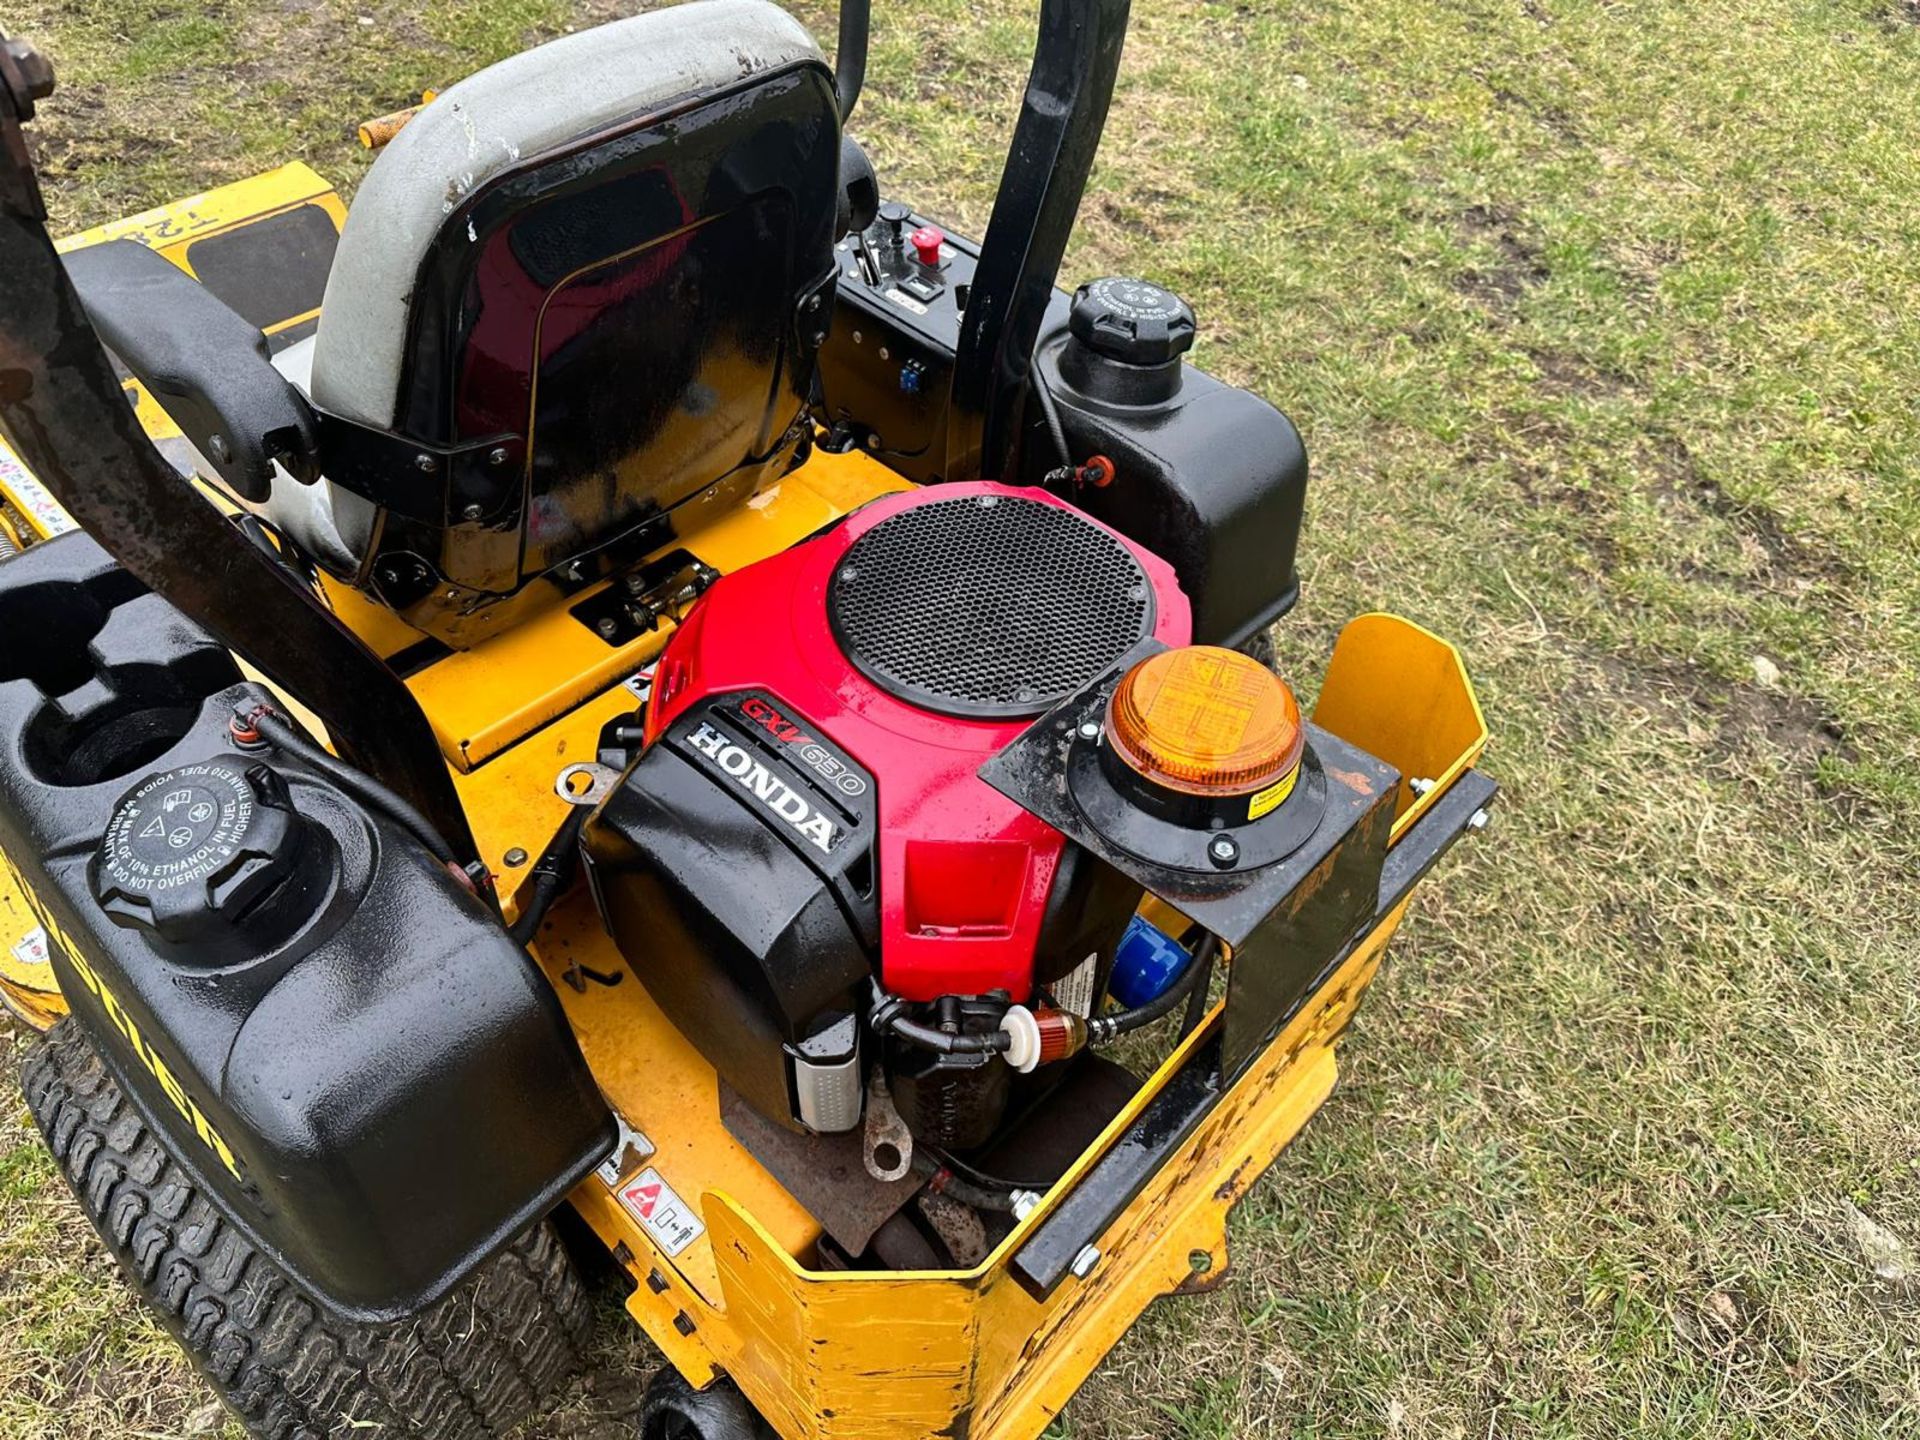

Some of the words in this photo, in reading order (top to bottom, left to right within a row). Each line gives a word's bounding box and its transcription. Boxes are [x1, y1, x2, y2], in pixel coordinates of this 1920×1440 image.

[179, 765, 211, 776] FUEL
[210, 765, 232, 779] E10
[136, 773, 174, 799] VOIDS
[228, 775, 250, 801] THAN
[687, 721, 833, 854] HONDA
[220, 799, 236, 828] FUEL
[229, 801, 252, 844] HIGHER
[104, 799, 137, 861] WARRANTY
[116, 819, 134, 846] MAX
[212, 830, 227, 844] IN
[118, 845, 132, 860] OF
[153, 845, 216, 876] ETHANOL
[113, 866, 129, 882] DO
[127, 858, 150, 876] 10%
[157, 857, 221, 890] OVERFILL
[128, 877, 155, 890] NOT
